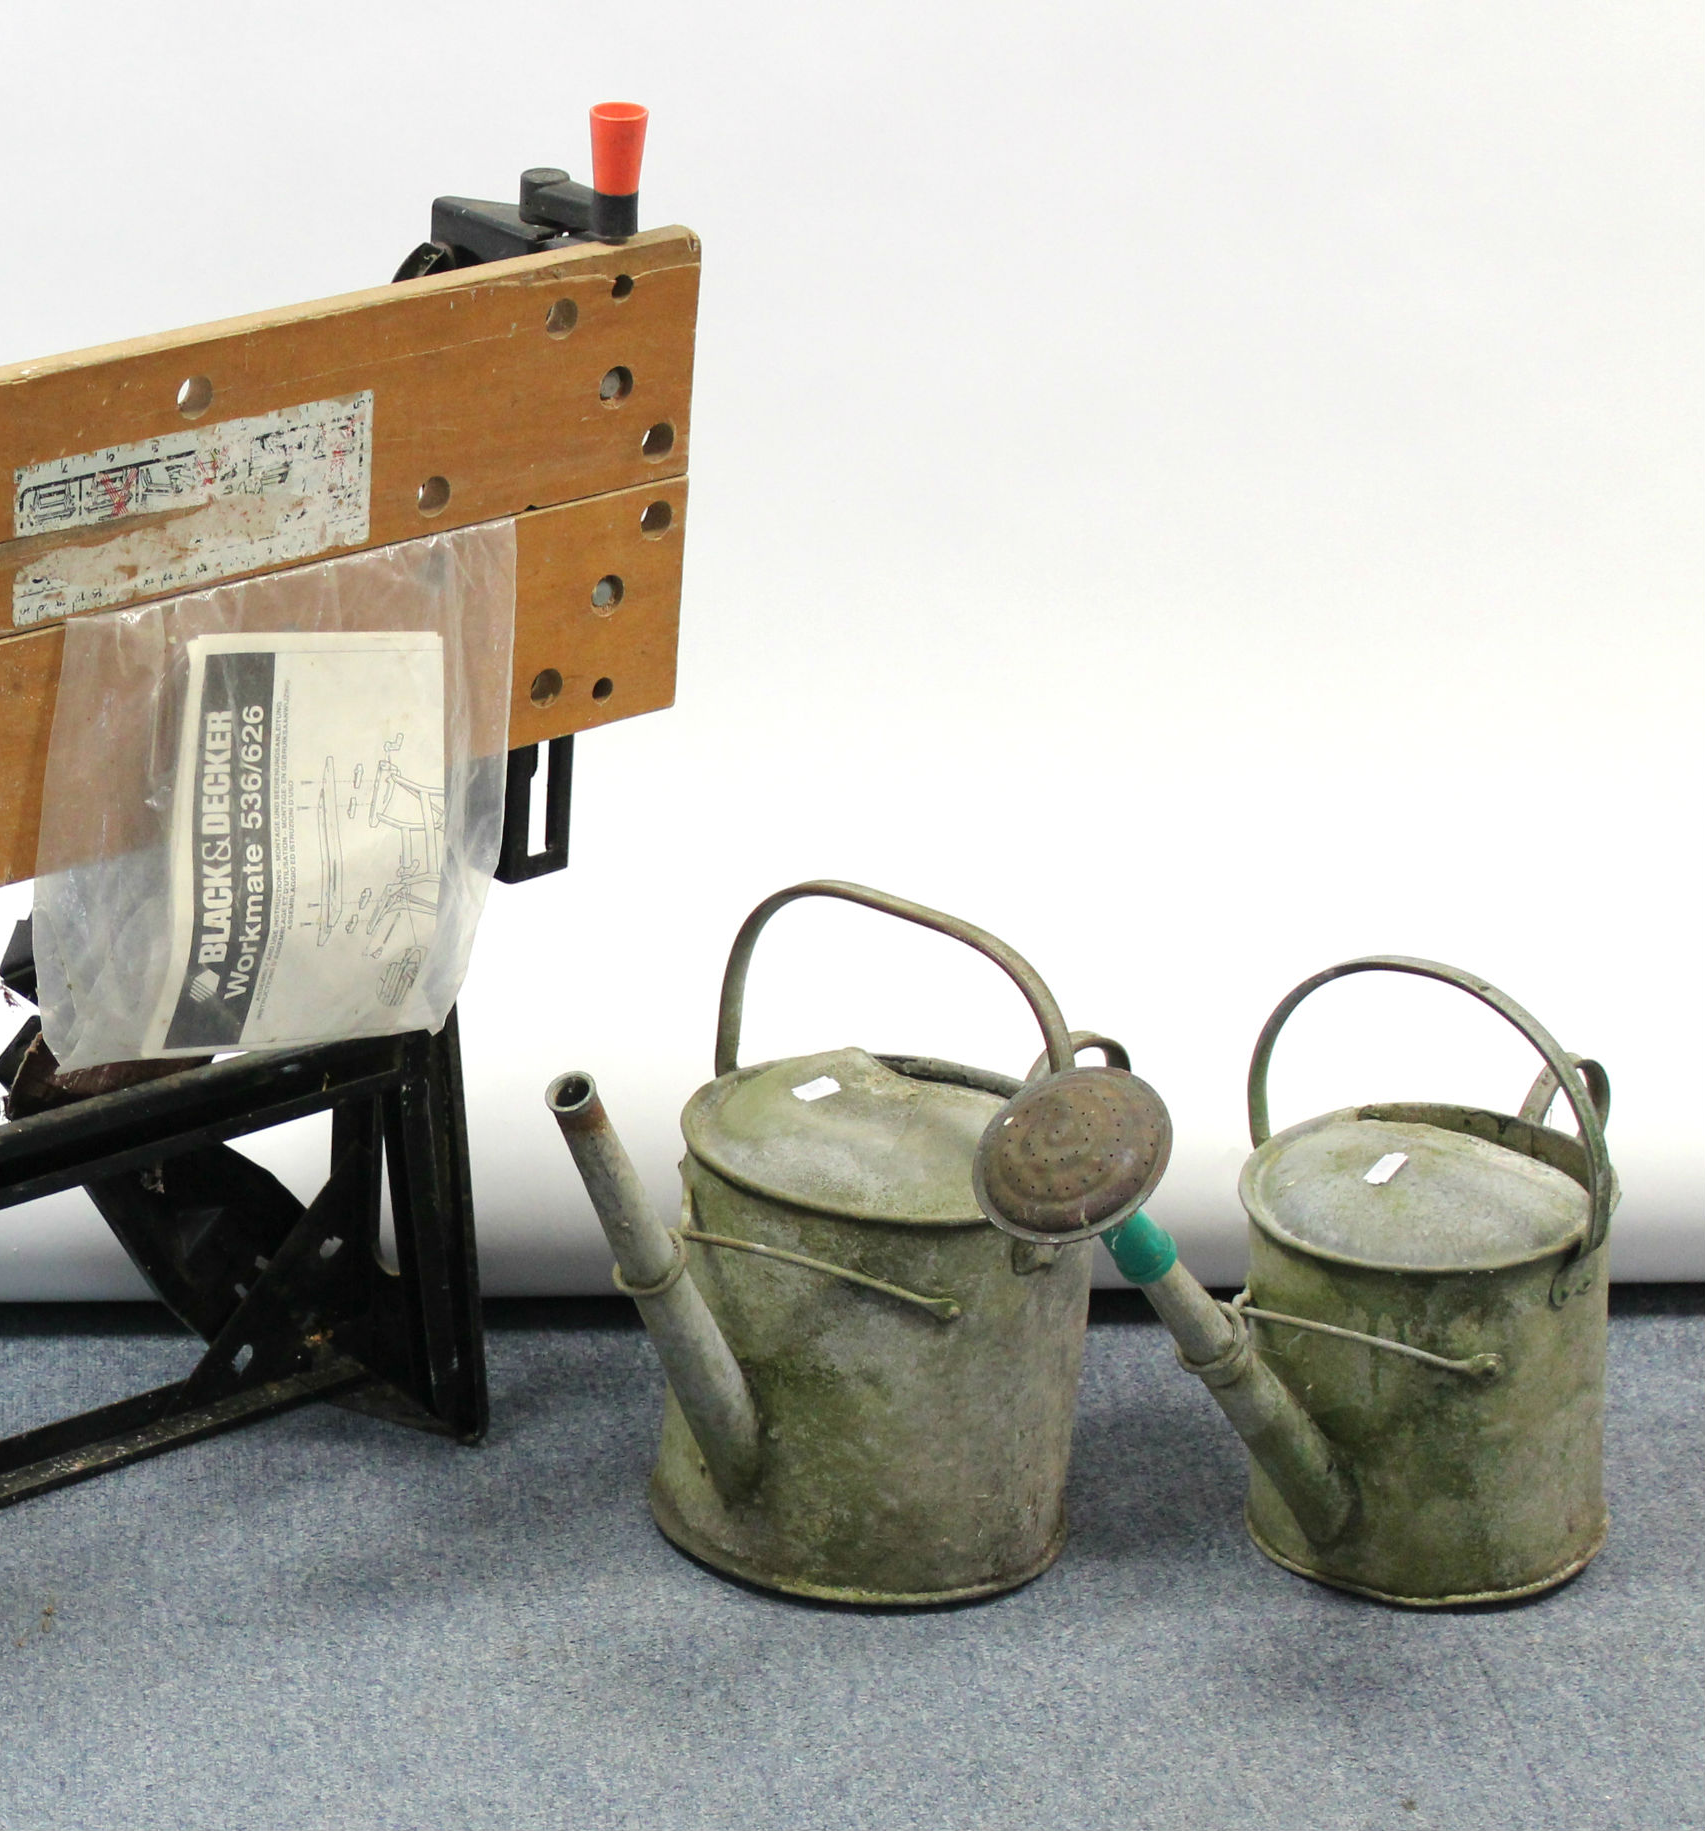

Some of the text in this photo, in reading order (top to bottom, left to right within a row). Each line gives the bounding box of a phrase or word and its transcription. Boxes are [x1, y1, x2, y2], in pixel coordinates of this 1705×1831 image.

[274, 701, 282, 800] BEDIENUNGSANLEITUNG
[223, 705, 265, 1000] Workmate 536/626
[274, 821, 282, 861] MONTAGE
[288, 807, 296, 852] ISTRUZIONI
[282, 837, 290, 894] D'UTILISATION
[272, 869, 282, 929] INSTRUCTIONS
[287, 867, 296, 930] ASSEMBLAGGIO
